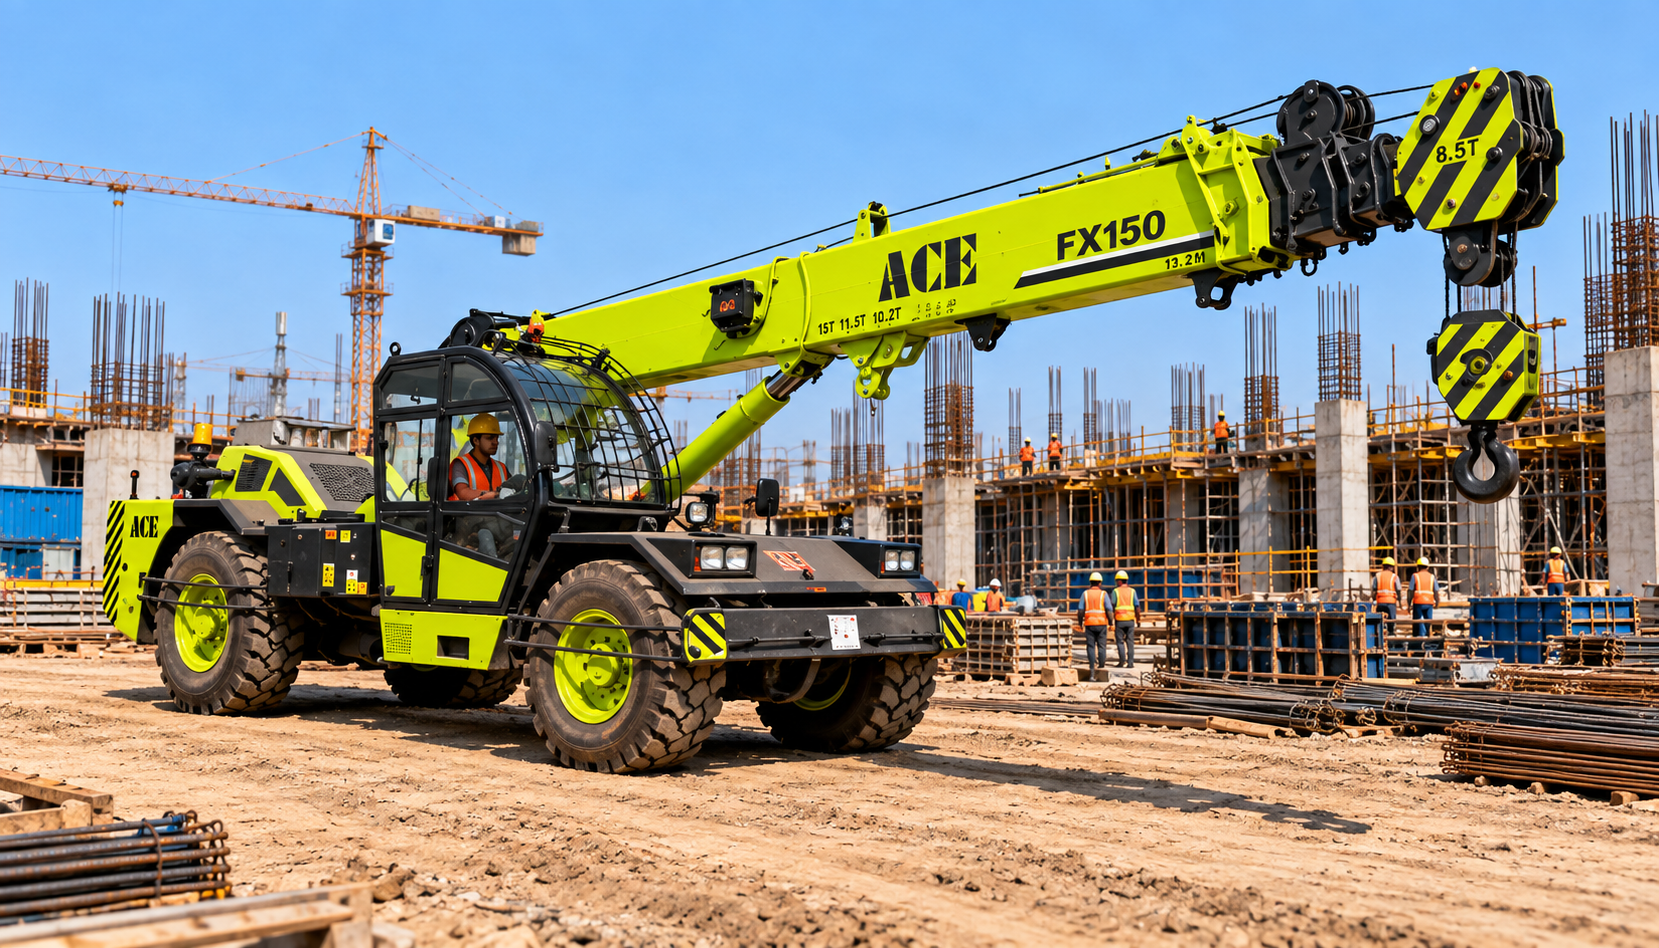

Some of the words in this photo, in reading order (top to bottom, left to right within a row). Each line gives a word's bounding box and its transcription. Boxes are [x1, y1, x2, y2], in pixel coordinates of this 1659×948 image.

[1435, 138, 1480, 164] 8.5T
[1057, 209, 1166, 261] FX150
[878, 232, 977, 303] ACE
[1165, 251, 1206, 270] 13.2M
[818, 320, 835, 335] 15T
[839, 313, 866, 331] 11.5T
[872, 306, 902, 324] 10.2T
[129, 515, 159, 538] ACE
